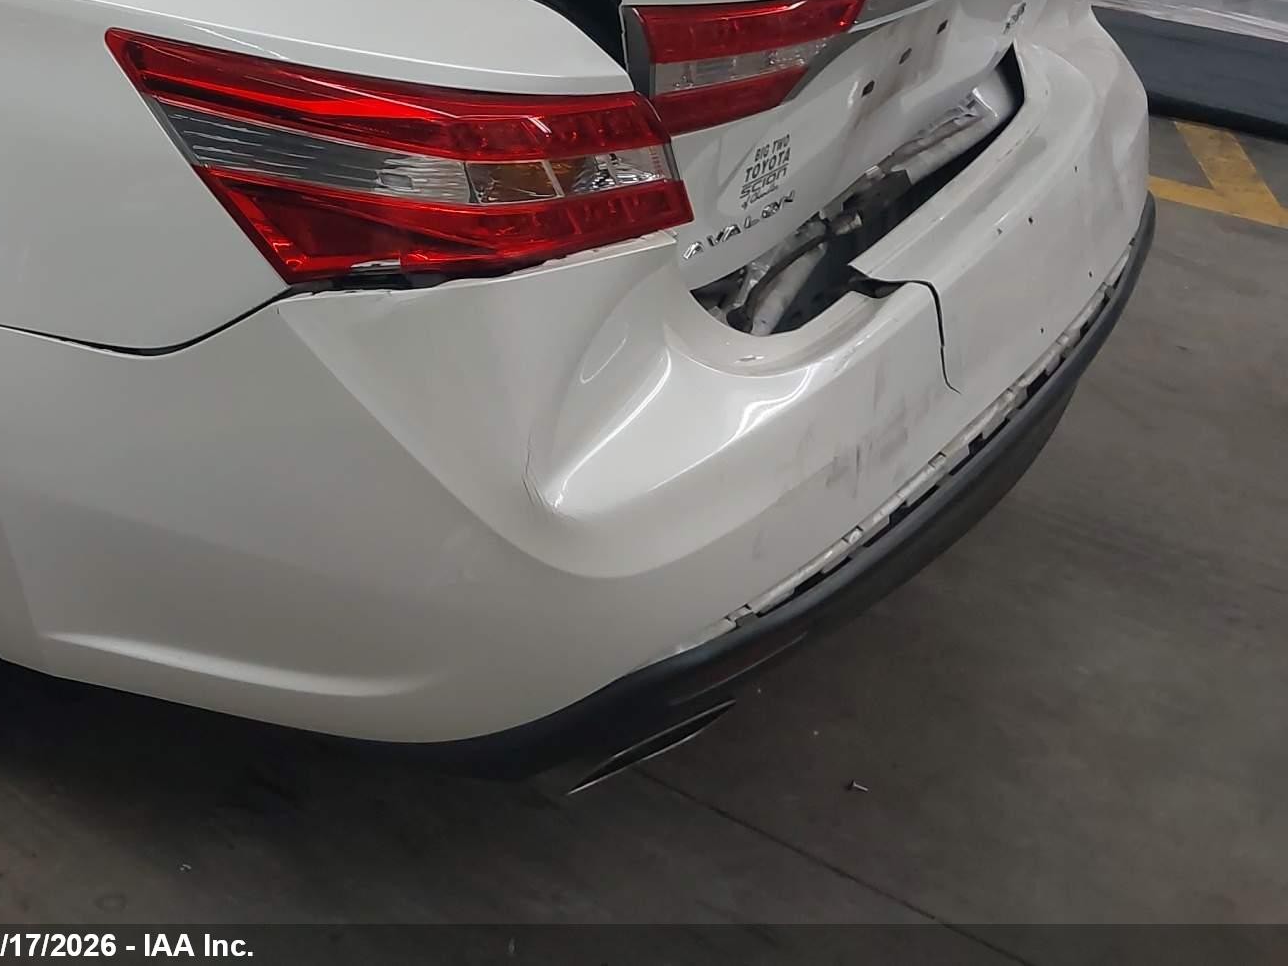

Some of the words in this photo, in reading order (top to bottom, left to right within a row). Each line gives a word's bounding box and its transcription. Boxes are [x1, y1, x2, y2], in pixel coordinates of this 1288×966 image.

[745, 147, 790, 182] TOYOTA
[755, 144, 770, 161] BIG
[772, 134, 790, 154] TWO
[682, 189, 795, 260] AVALON
